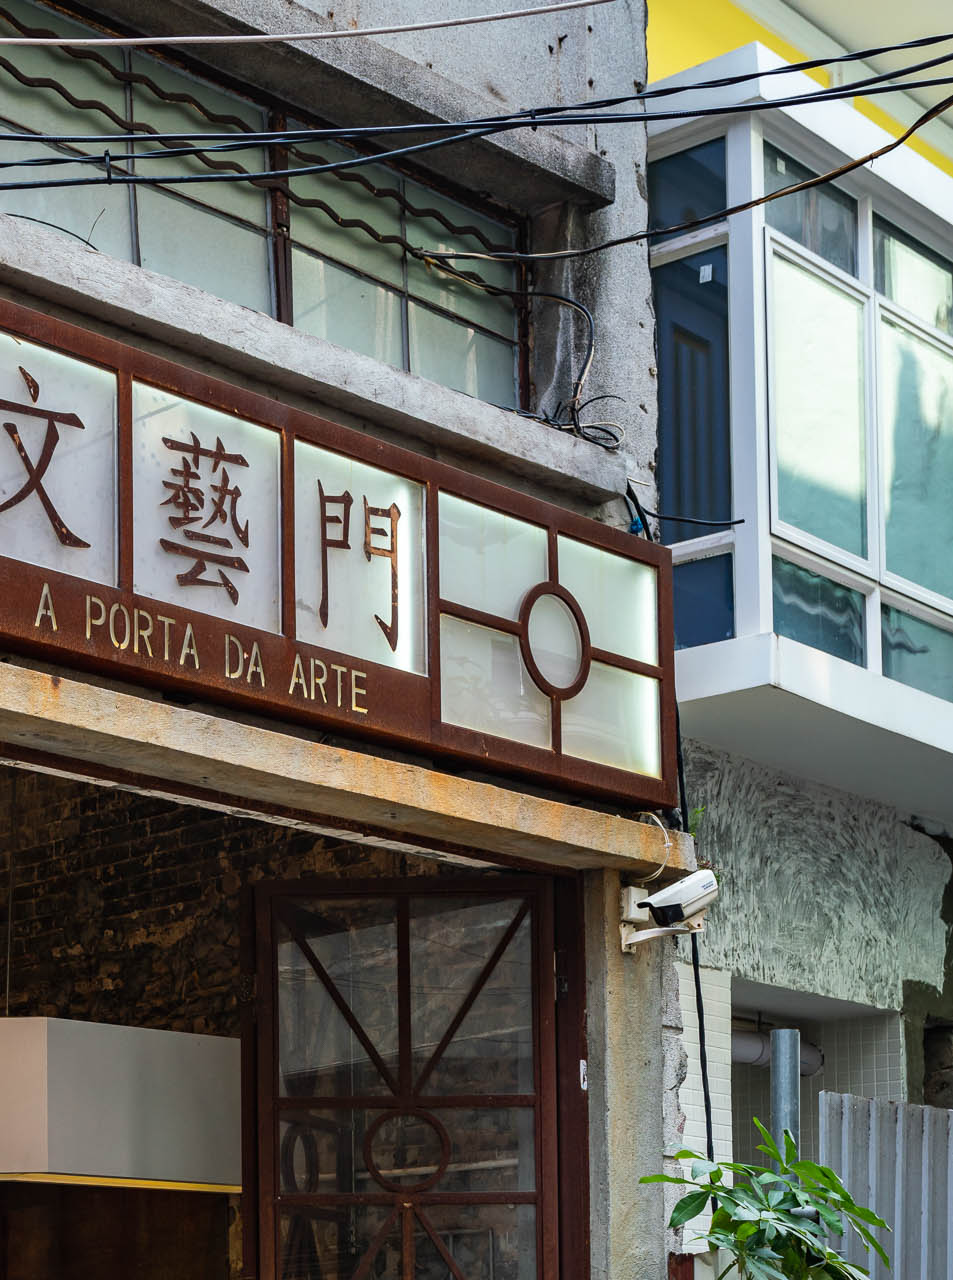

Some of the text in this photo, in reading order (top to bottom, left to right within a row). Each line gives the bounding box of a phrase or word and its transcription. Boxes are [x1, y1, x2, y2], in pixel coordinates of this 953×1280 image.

[34, 583, 369, 714] A PORTA DA ARTE
